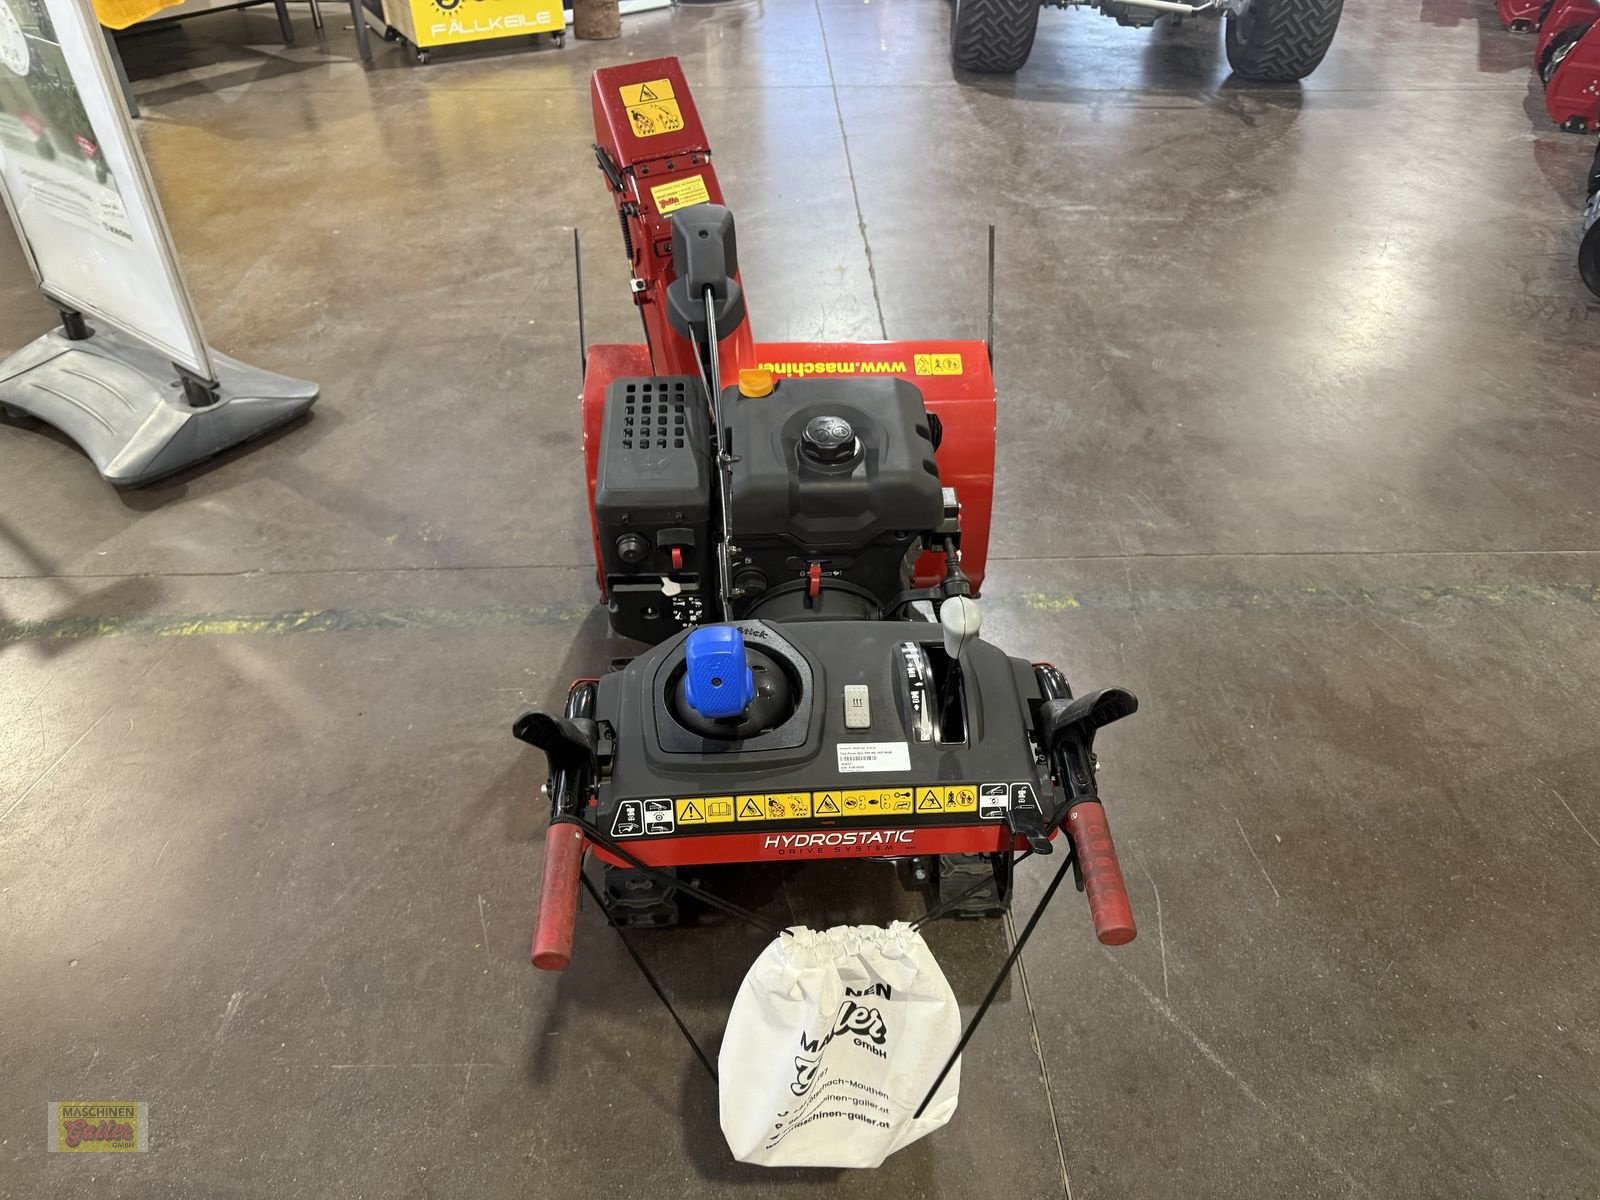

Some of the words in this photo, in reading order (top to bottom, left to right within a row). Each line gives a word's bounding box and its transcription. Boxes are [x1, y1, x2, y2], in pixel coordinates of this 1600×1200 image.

[431, 11, 551, 38] FÄLLKEILE
[765, 829, 915, 849] HYDROSTATIC
[778, 847, 823, 855] DRIVE
[834, 844, 894, 853] SYSTEM
[853, 1037, 887, 1059] GmbH
